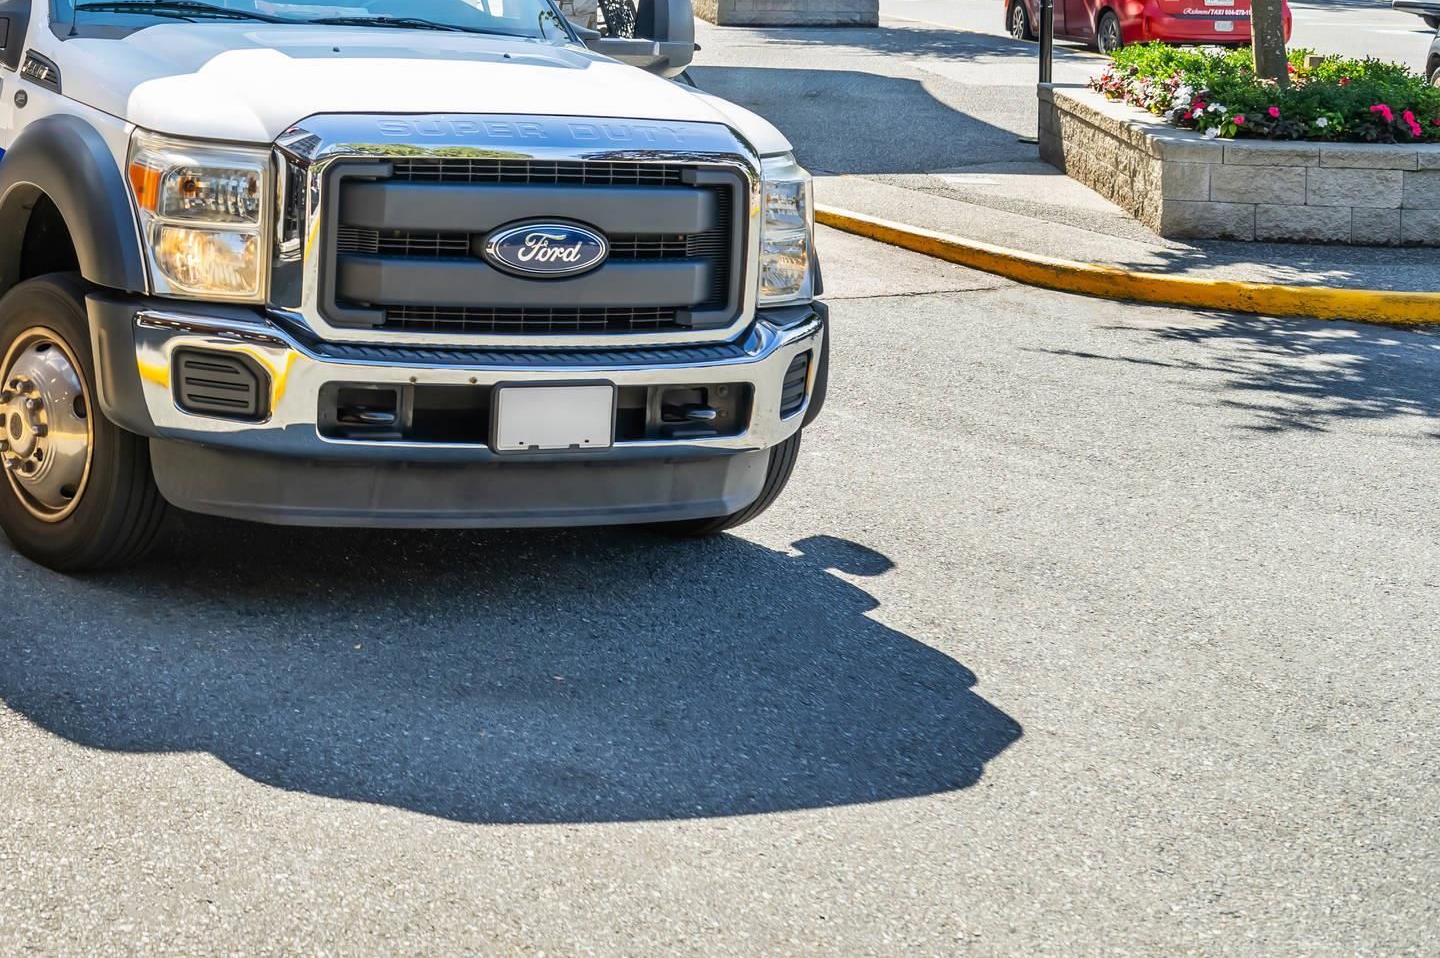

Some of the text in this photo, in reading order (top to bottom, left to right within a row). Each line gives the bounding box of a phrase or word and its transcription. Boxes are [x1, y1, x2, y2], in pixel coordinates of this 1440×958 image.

[376, 119, 689, 142] SUPER DUTY
[517, 232, 583, 263] Ford
